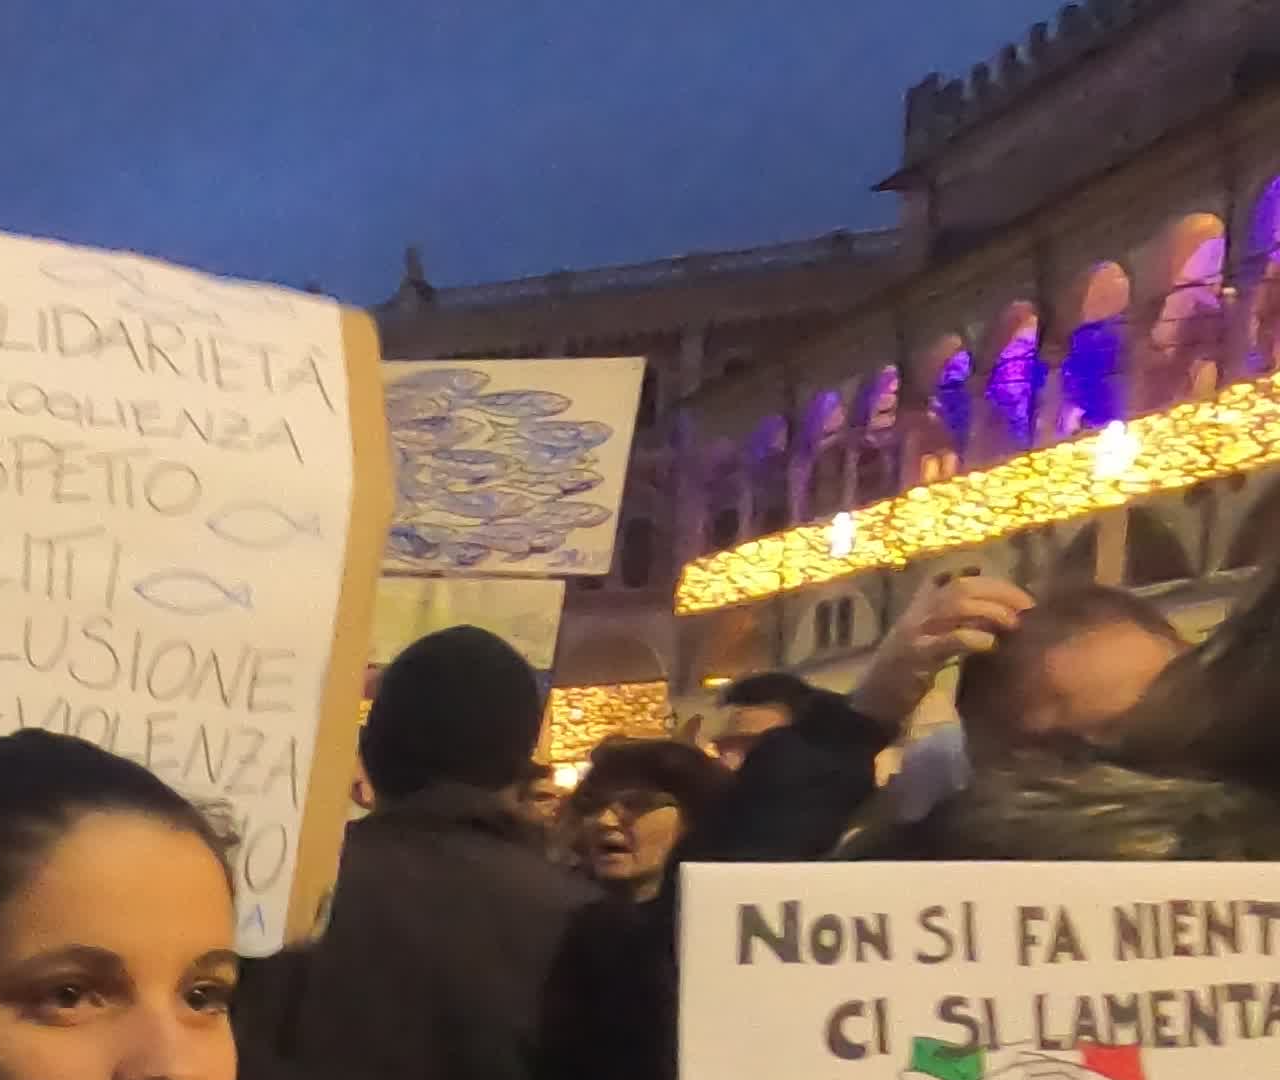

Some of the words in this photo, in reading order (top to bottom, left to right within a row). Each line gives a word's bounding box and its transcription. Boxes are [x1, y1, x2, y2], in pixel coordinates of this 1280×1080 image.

[737, 901, 890, 966] NON
[916, 902, 977, 964] SI
[1017, 906, 1085, 966] FA
[825, 998, 889, 1060] CI
[936, 997, 999, 1055] SI
